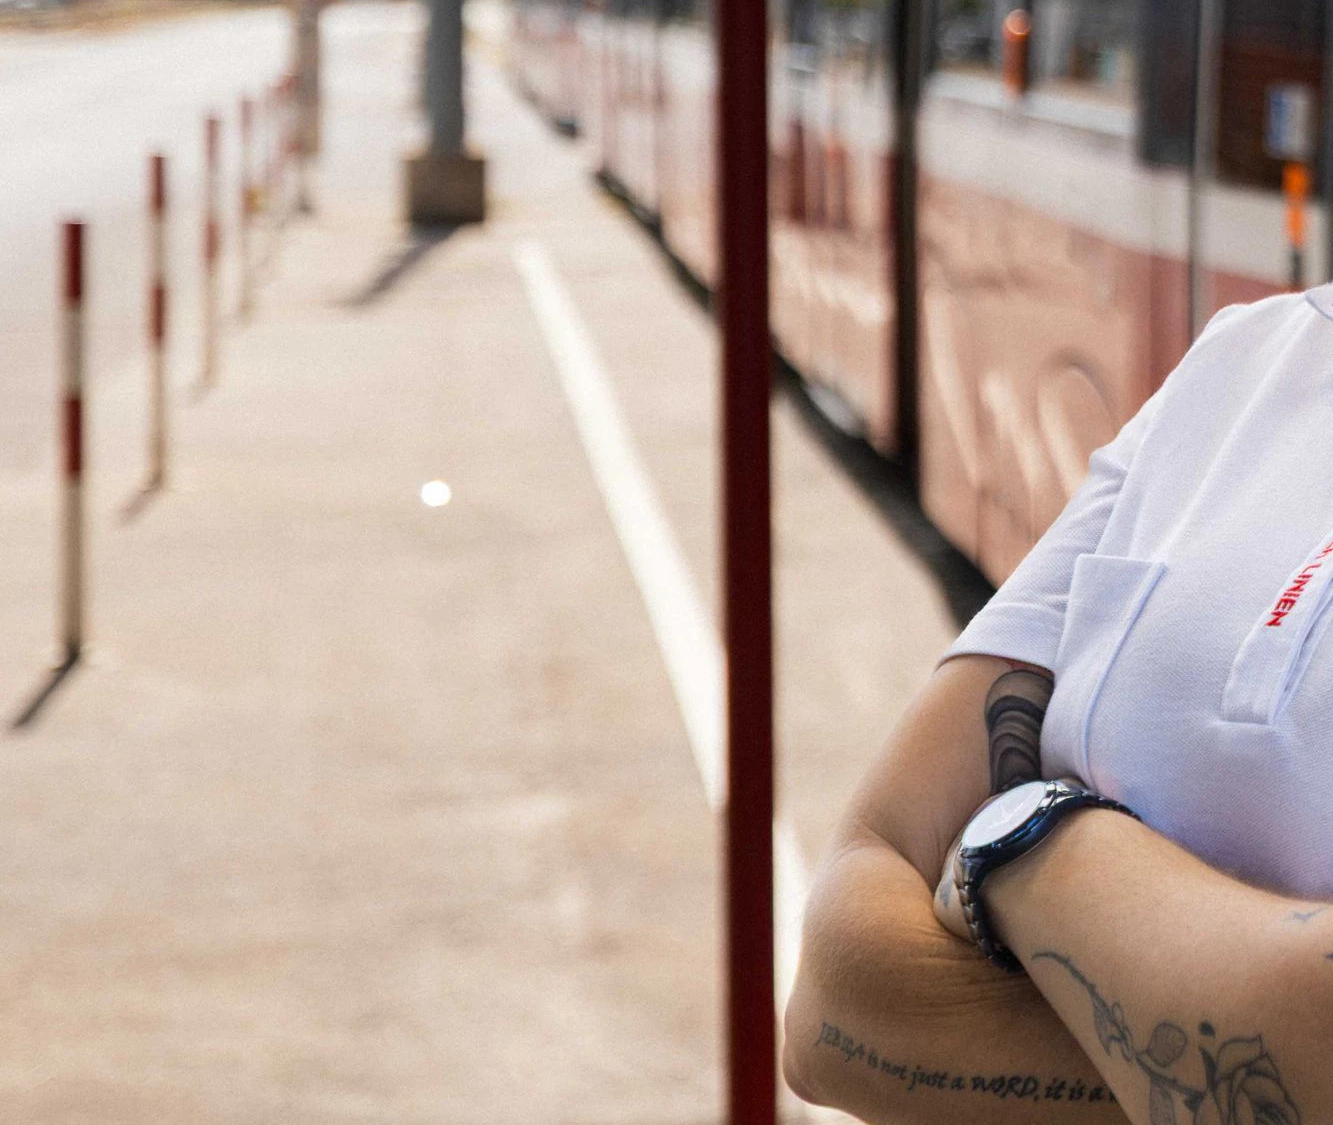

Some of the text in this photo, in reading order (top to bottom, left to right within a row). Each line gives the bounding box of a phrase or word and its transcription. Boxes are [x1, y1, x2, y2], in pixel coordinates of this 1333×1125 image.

[1265, 562, 1322, 627] LINIEN
[907, 1064, 949, 1091] just
[951, 1075, 966, 1091] a
[1045, 1078, 1066, 1101] it
[1068, 1078, 1086, 1101] is
